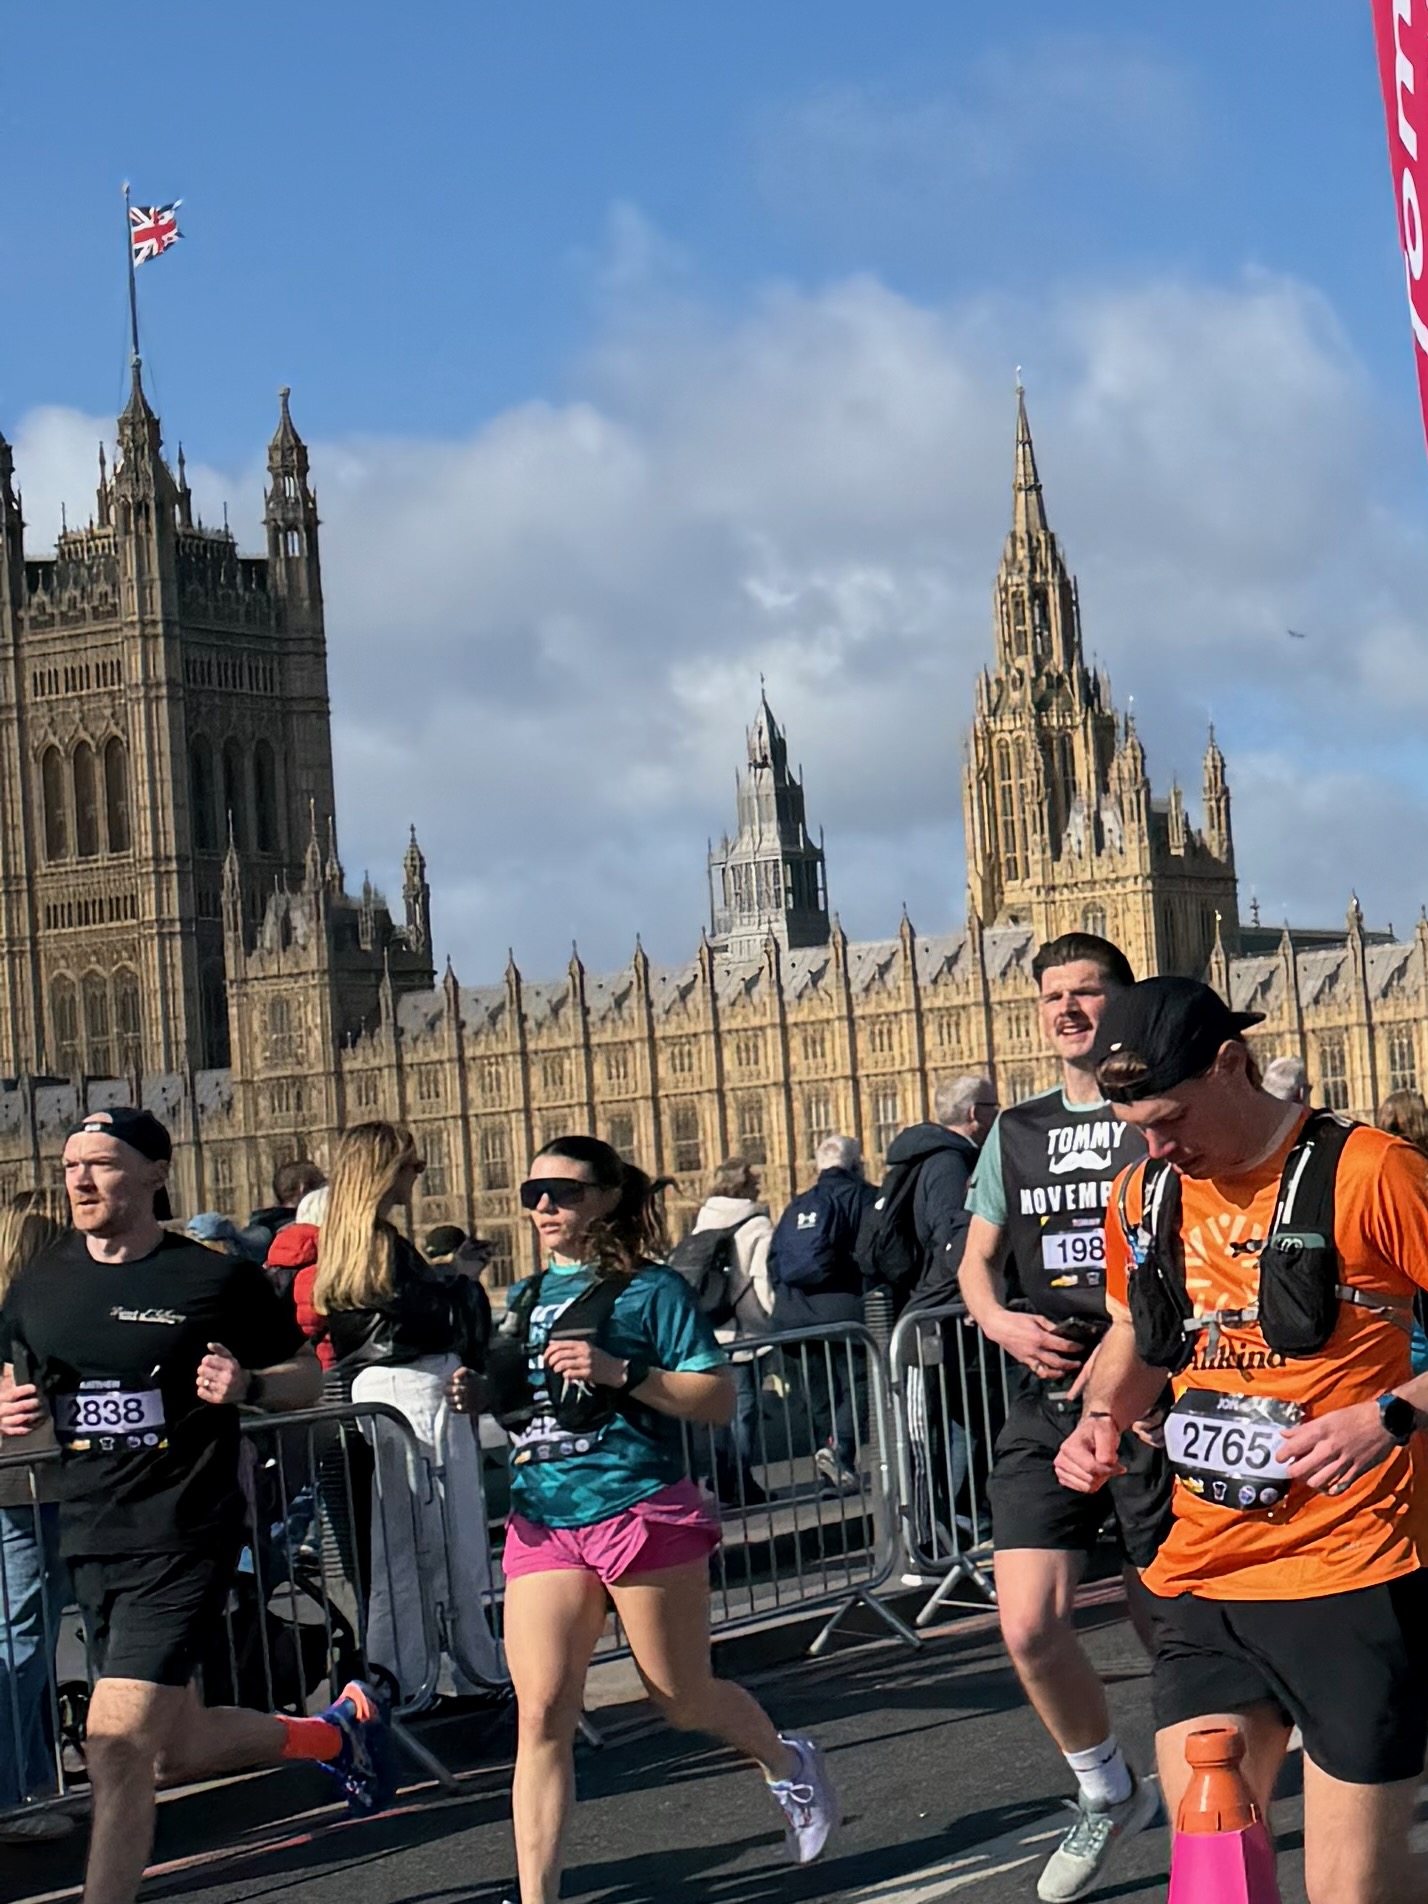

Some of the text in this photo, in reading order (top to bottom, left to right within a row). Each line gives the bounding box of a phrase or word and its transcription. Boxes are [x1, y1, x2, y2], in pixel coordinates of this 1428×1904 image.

[1047, 1121, 1127, 1155] TOMMY
[1020, 1181, 1113, 1215] NOVEMB
[1058, 1235, 1106, 1263] 198
[69, 1398, 145, 1427] 2838
[1183, 1421, 1273, 1470] 2765
